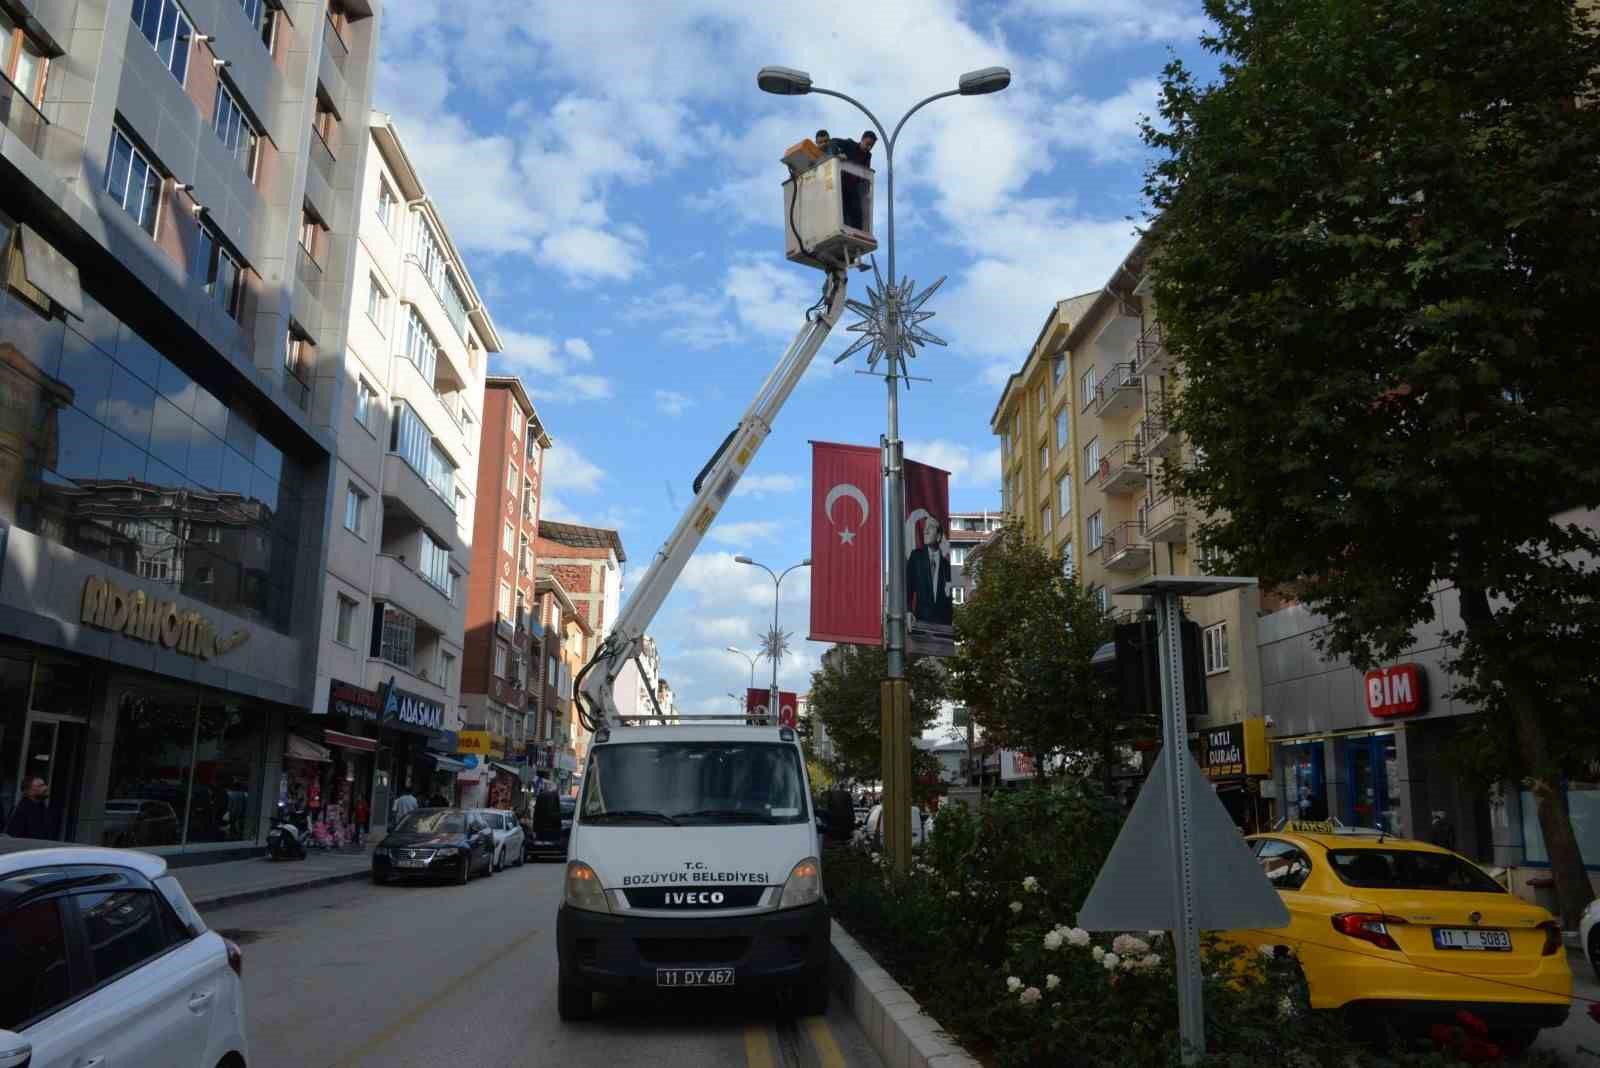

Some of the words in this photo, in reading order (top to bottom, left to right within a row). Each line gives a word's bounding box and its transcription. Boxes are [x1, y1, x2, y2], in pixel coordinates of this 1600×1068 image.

[1367, 668, 1413, 708] BİM
[399, 695, 441, 728] ADASMAK
[1209, 730, 1231, 747] TATLI
[1209, 745, 1241, 765] DURAĞI
[683, 862, 707, 870] T.C.
[623, 871, 689, 886] BOZÜYÜK
[693, 870, 769, 884] BELEDİYESİ
[664, 892, 725, 905] IVECO
[1442, 931, 1453, 945] 11
[1463, 931, 1470, 945] T
[1479, 932, 1508, 946] 5083
[664, 971, 677, 984] 11
[684, 971, 703, 984] DY
[707, 970, 730, 984] 467
